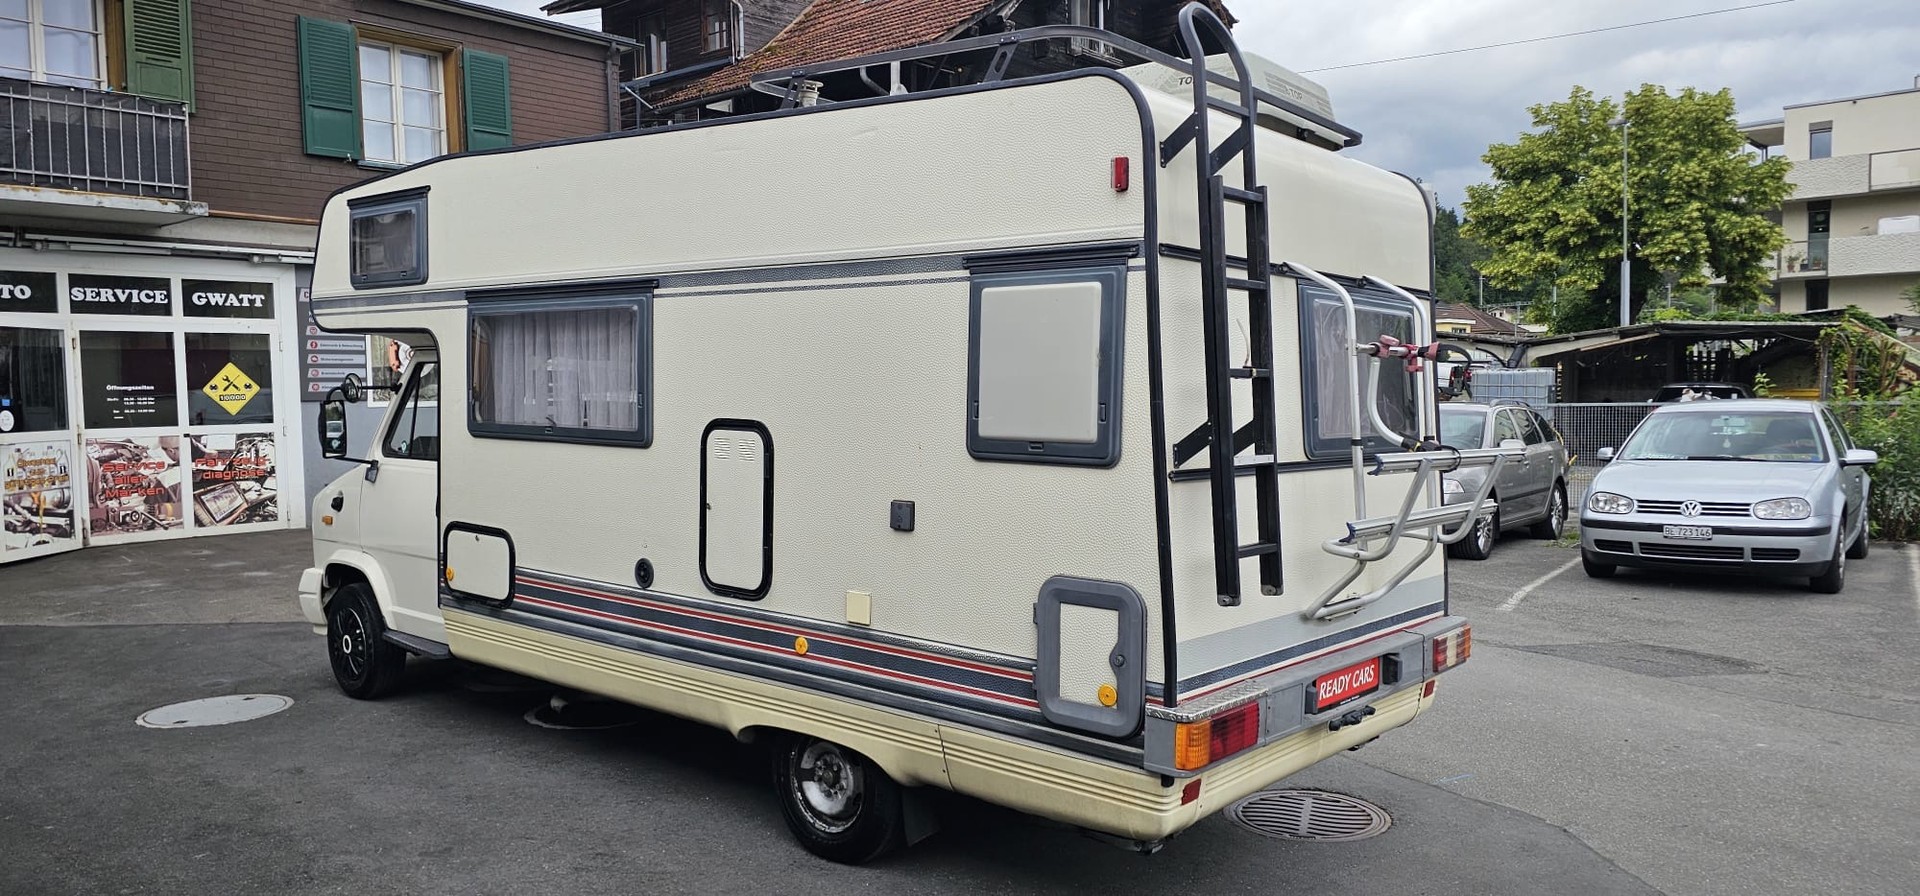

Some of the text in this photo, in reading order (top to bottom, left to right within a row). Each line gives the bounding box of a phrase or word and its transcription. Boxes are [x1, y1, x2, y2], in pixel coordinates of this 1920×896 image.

[70, 286, 168, 304] SERVICE
[191, 292, 266, 307] GWATT
[102, 461, 166, 472] Service
[115, 475, 149, 485] aller
[203, 469, 265, 480] diagnose
[105, 487, 165, 498] Marken
[1665, 527, 1675, 535] BE
[1319, 664, 1375, 700] READY CARS
